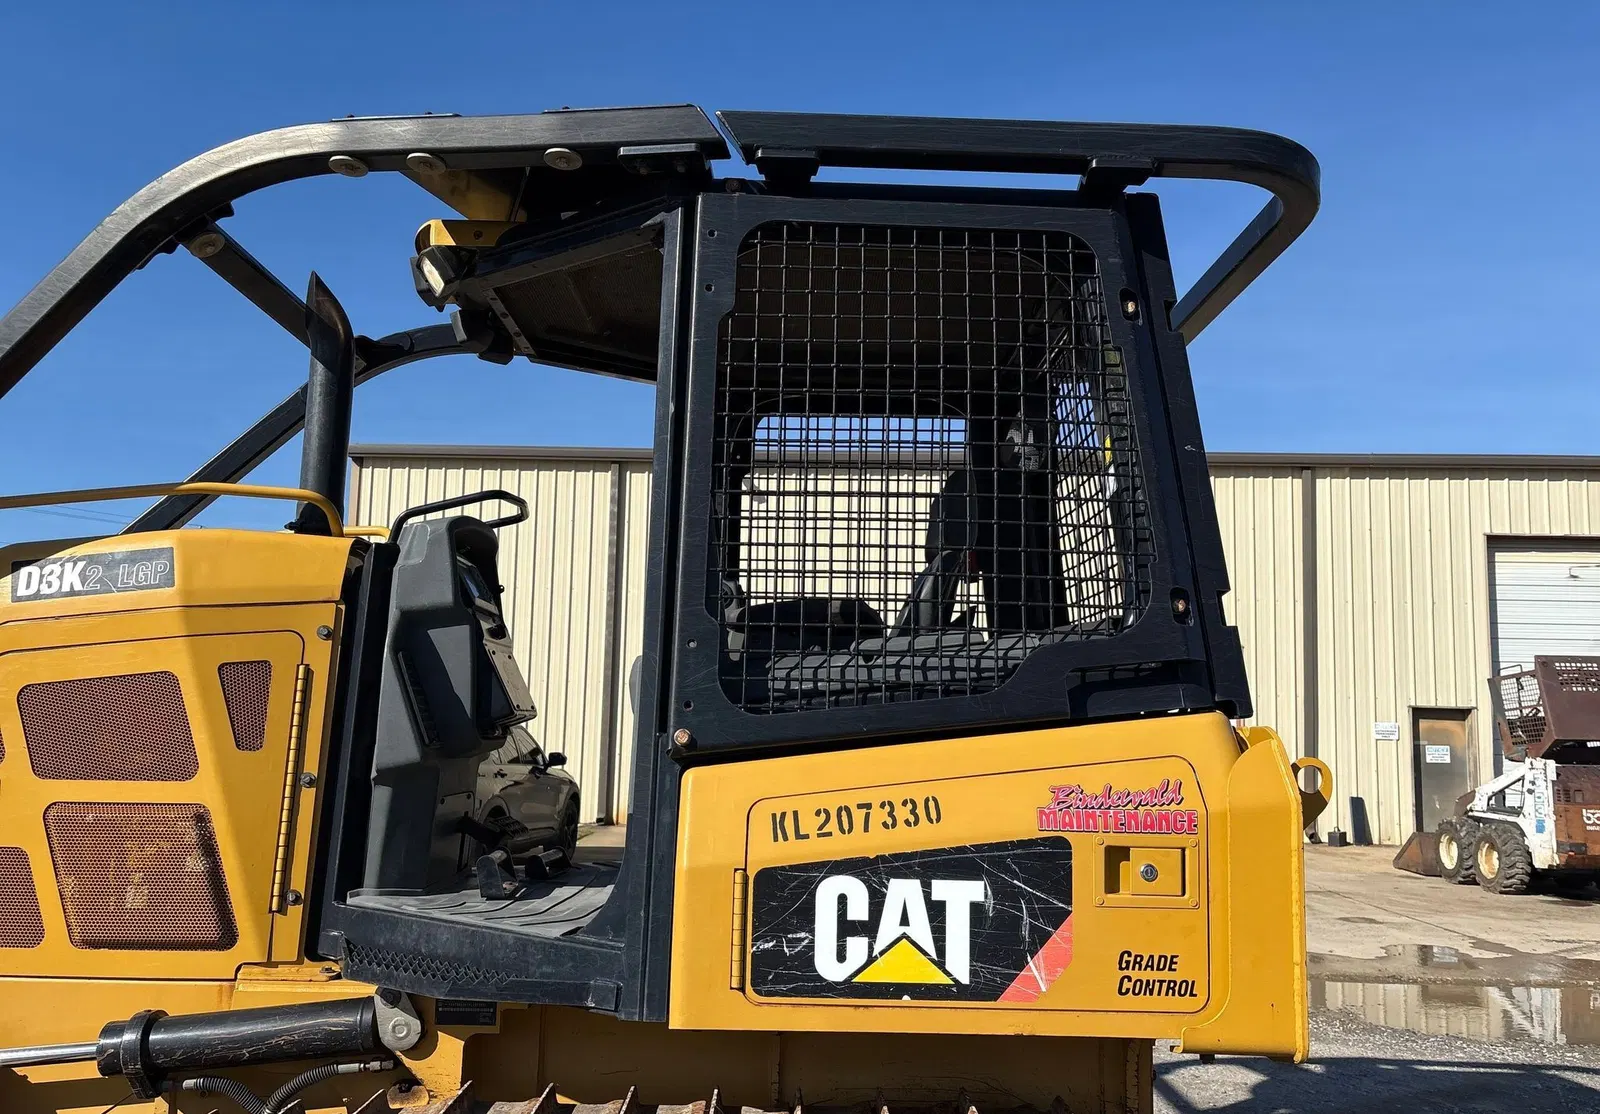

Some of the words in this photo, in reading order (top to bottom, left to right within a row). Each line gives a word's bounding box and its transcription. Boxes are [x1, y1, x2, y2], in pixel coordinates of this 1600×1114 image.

[118, 560, 170, 587] LGP
[1046, 778, 1184, 810] Bindewald
[771, 795, 942, 843] KL207330
[1037, 807, 1198, 834] MAINTENANCE
[814, 875, 985, 985] CAT
[1118, 950, 1180, 972] GRADE
[1117, 975, 1198, 998] CONTROL
